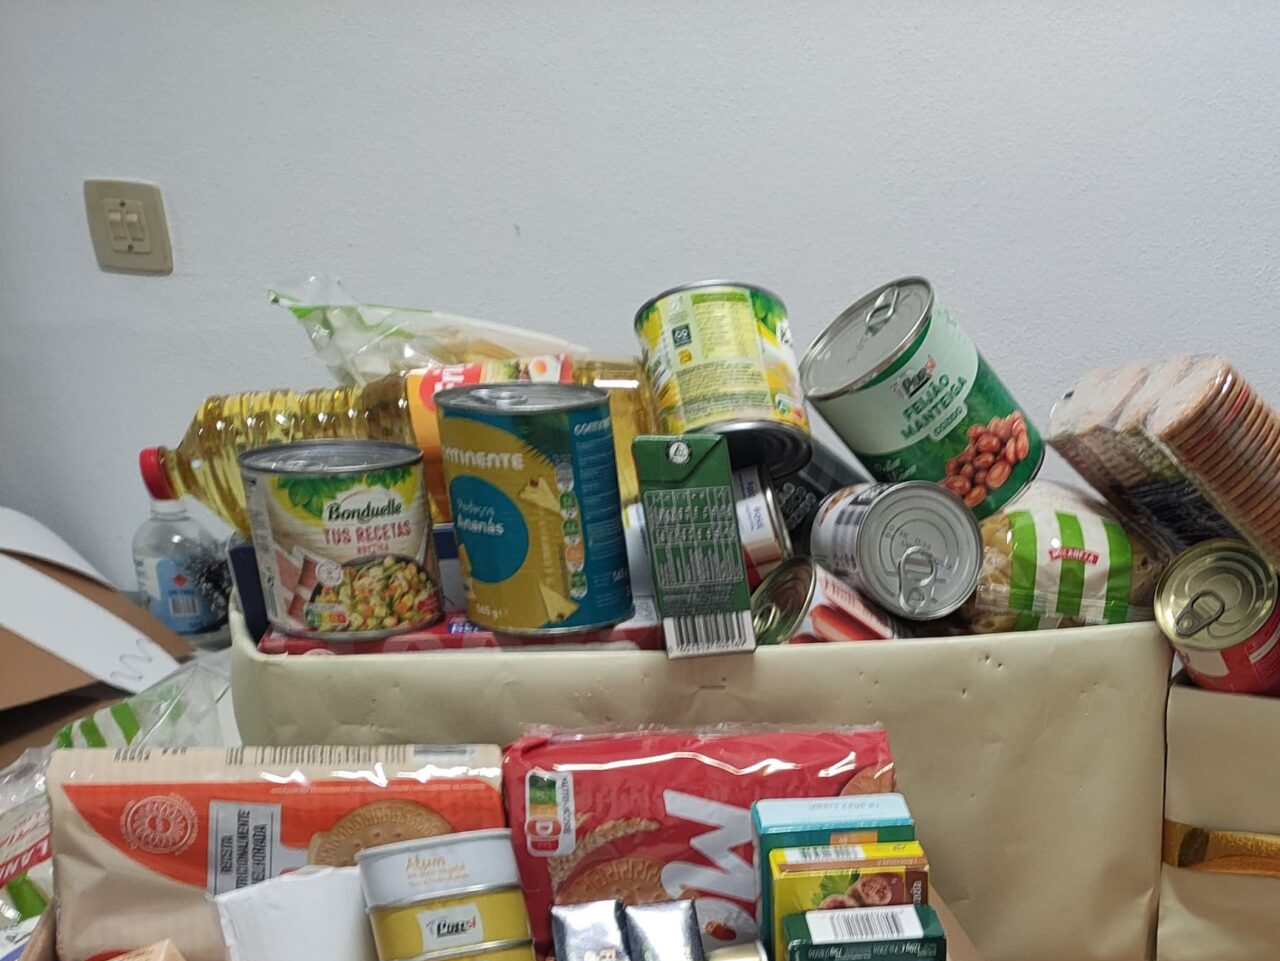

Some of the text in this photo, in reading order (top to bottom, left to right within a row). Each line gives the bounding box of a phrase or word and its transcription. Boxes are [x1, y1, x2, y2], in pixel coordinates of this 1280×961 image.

[327, 498, 403, 523] Bonduelle
[322, 519, 411, 545] TUS RECETAS
[406, 854, 446, 872] Atum
